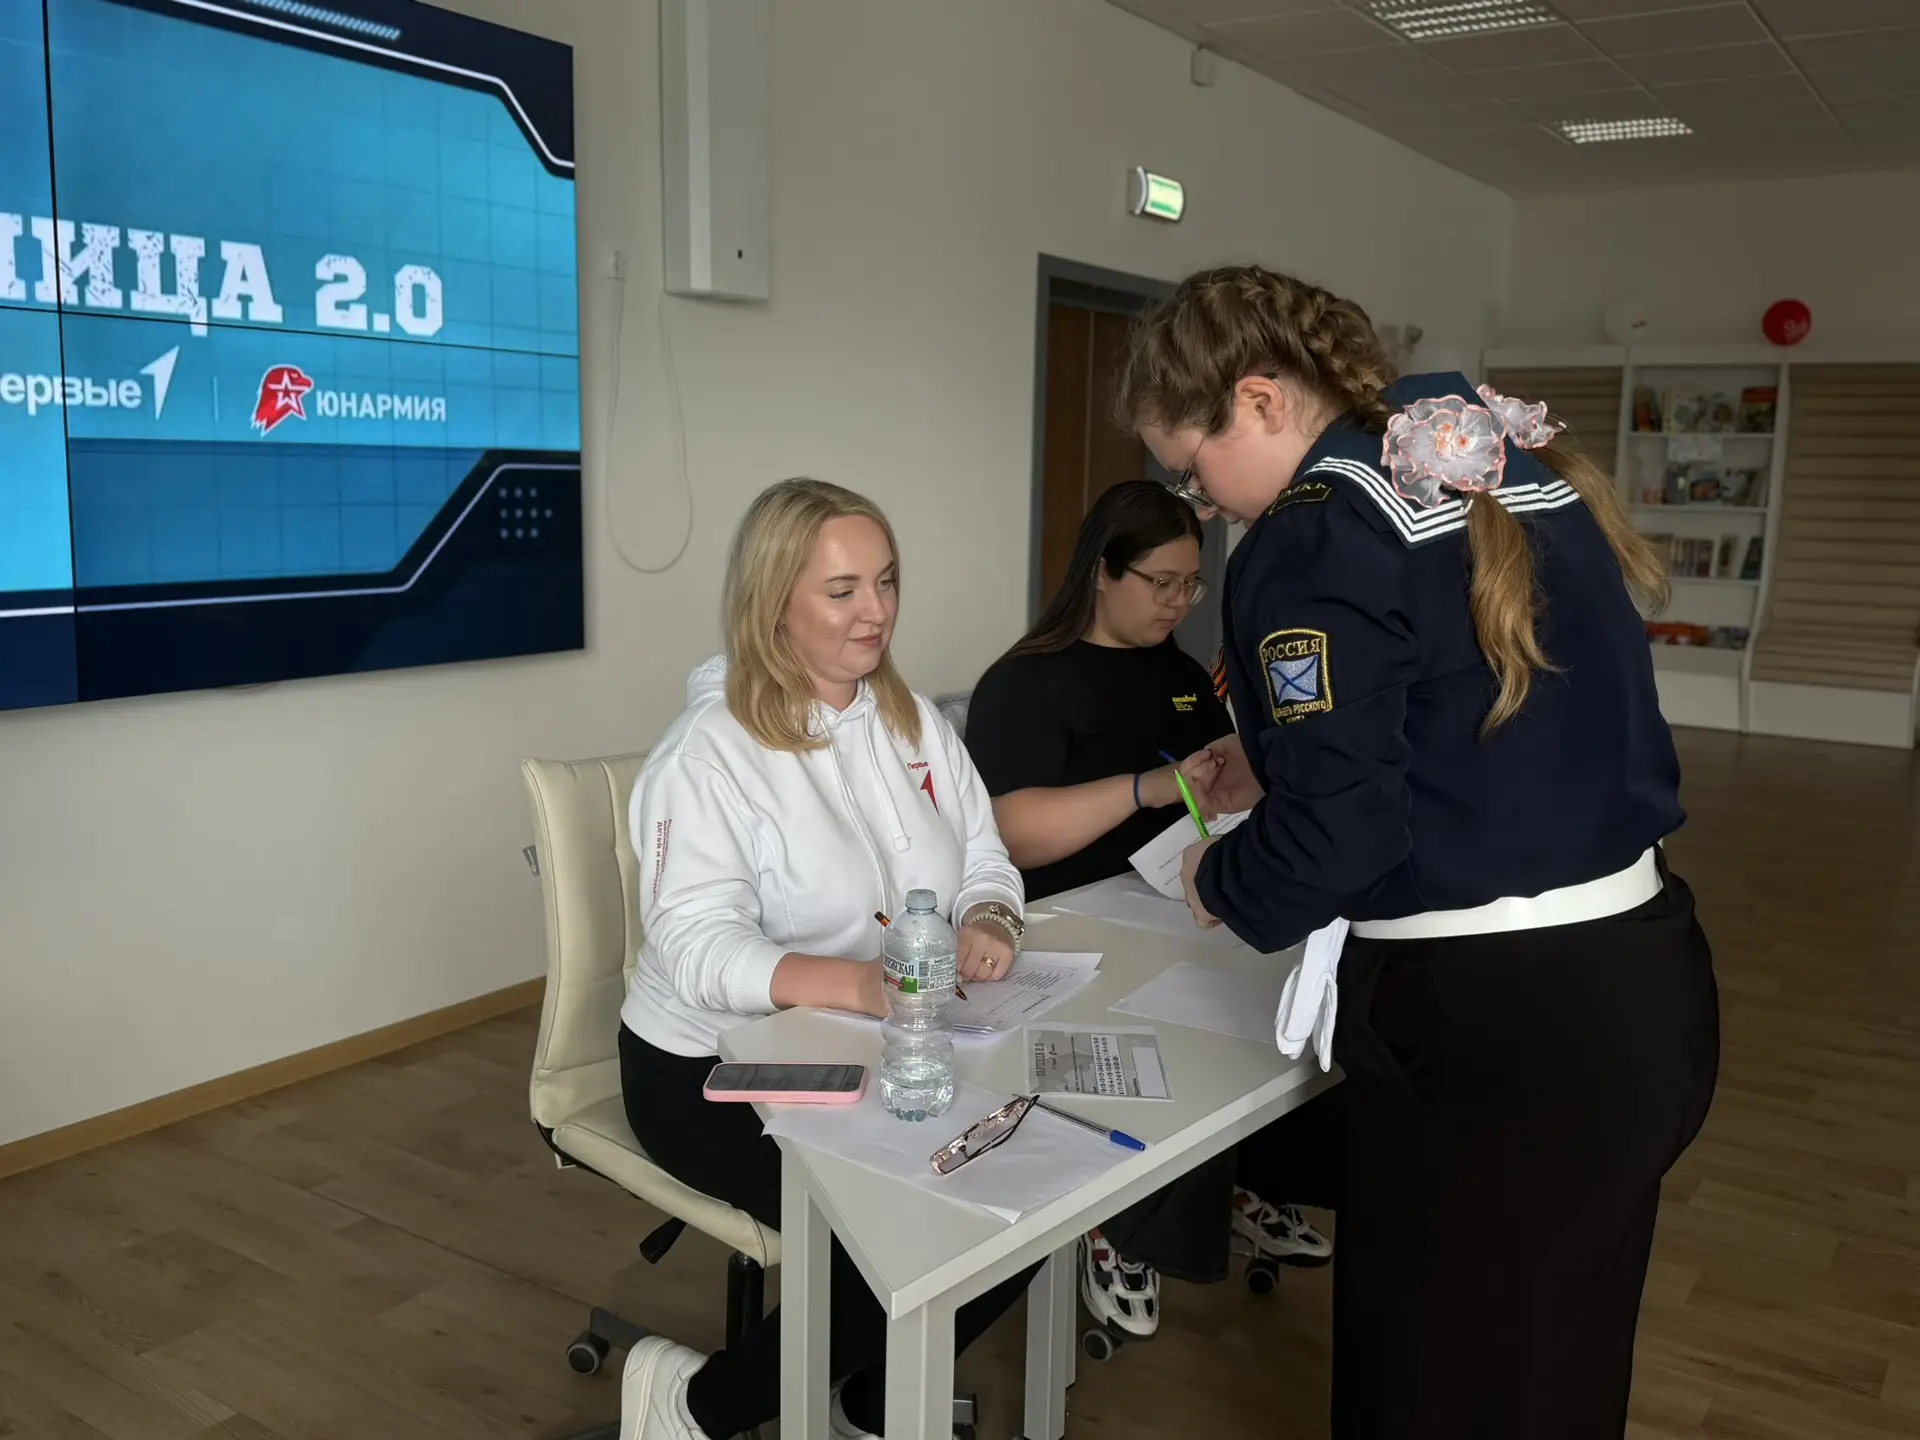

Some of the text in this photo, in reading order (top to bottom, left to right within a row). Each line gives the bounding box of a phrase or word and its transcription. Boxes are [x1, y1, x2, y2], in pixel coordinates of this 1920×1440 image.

[315, 254, 443, 336] 2.0
[316, 390, 446, 422] ЮНАРМИЯ
[1262, 638, 1321, 662] РОССИЯ
